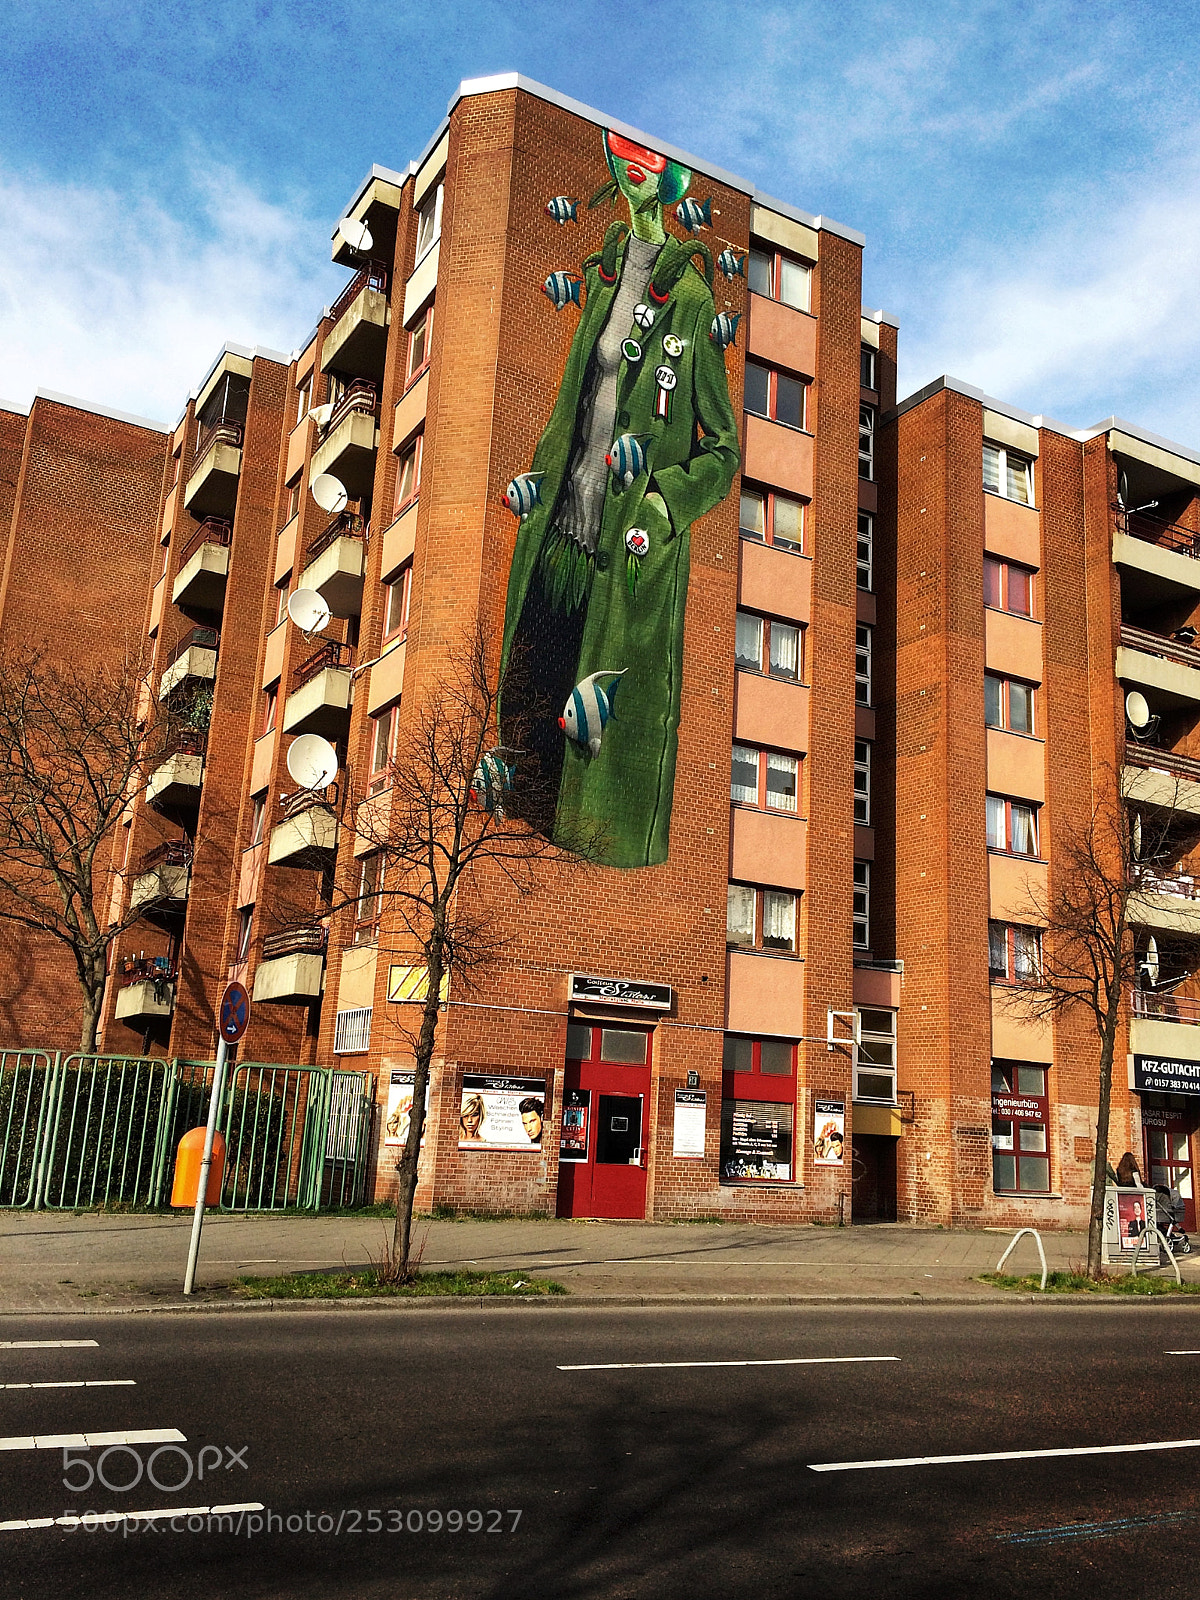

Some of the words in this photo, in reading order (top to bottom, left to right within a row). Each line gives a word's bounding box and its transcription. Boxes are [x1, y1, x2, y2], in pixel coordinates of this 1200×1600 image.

[1141, 1059, 1200, 1077] KFZ-GUTACHT
[1154, 1078, 1169, 1087] 0157
[1182, 1081, 1188, 1089] 70
[1189, 1082, 1200, 1090] 414
[992, 1096, 1039, 1109] Ingenieurbüro
